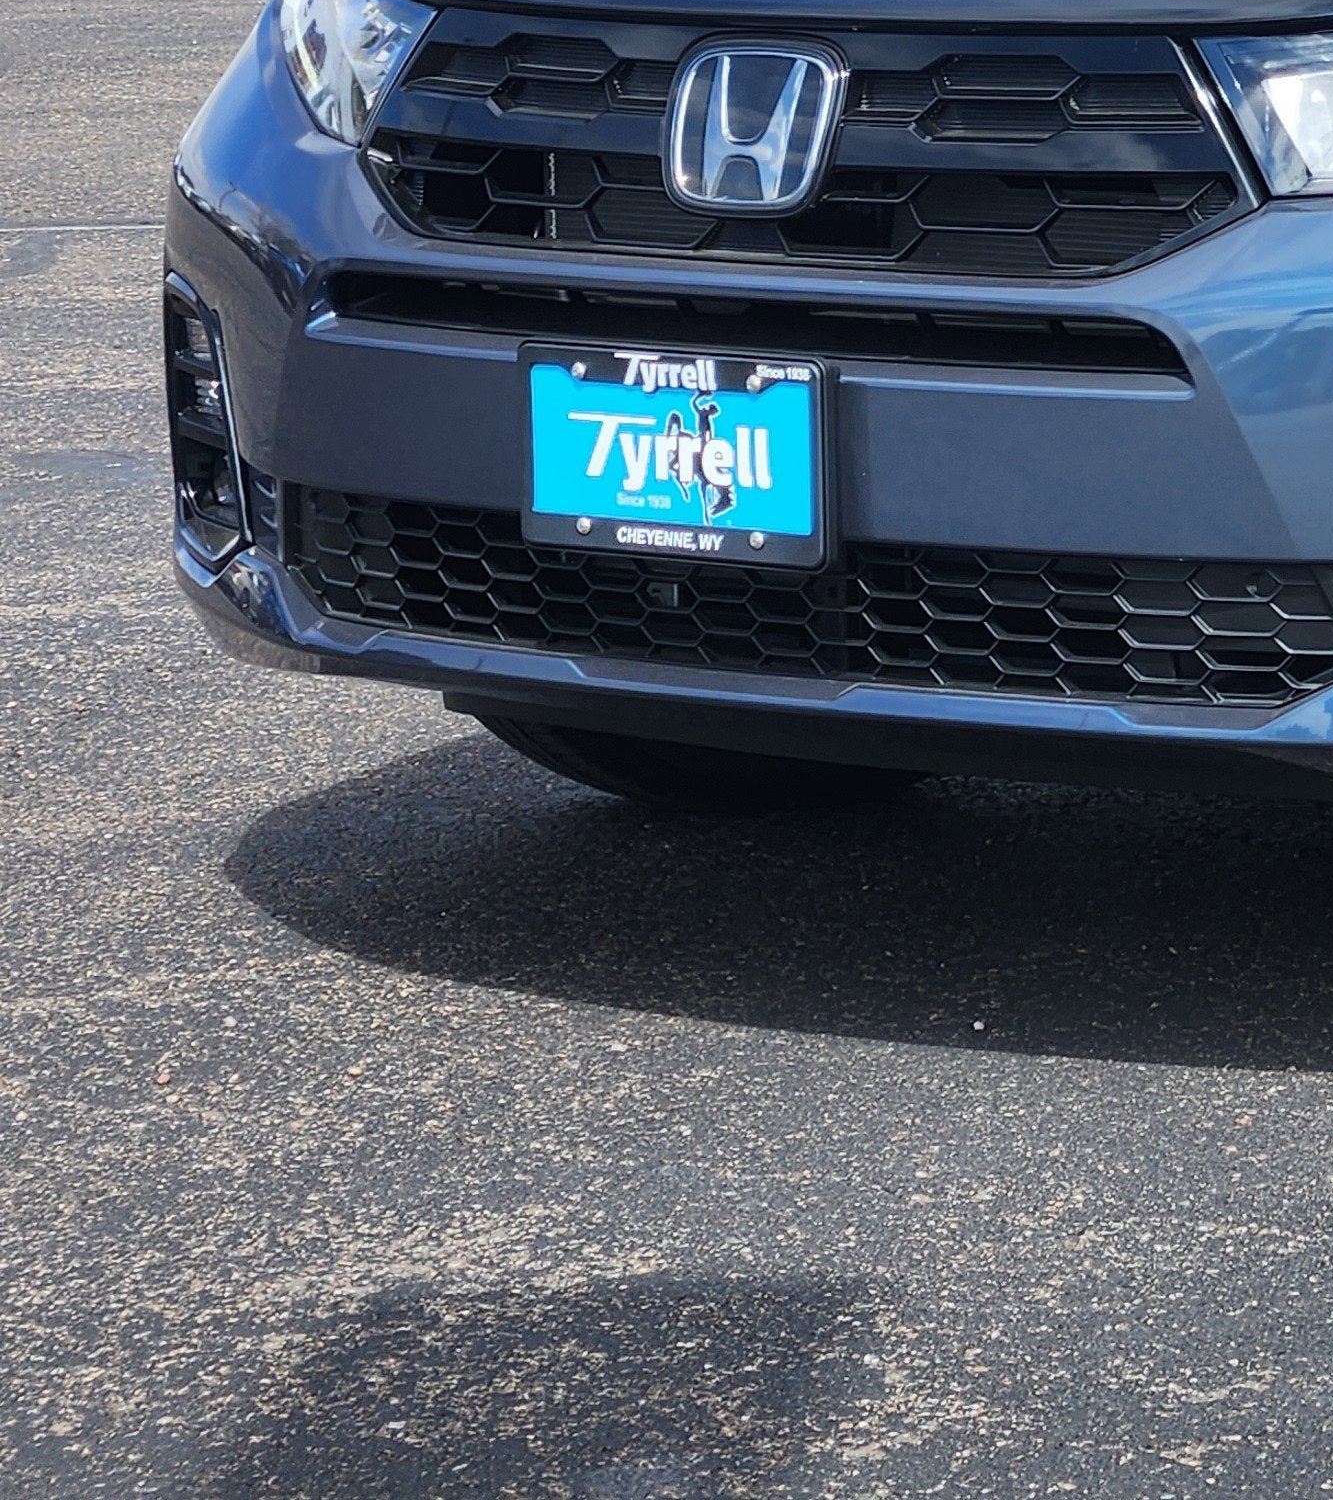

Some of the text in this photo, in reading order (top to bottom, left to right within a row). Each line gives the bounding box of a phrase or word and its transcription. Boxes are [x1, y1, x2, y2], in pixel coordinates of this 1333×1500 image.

[613, 352, 718, 393] Tyrrell
[567, 411, 773, 491] Tyrrell
[616, 526, 725, 552] CHEYENNE, WY
